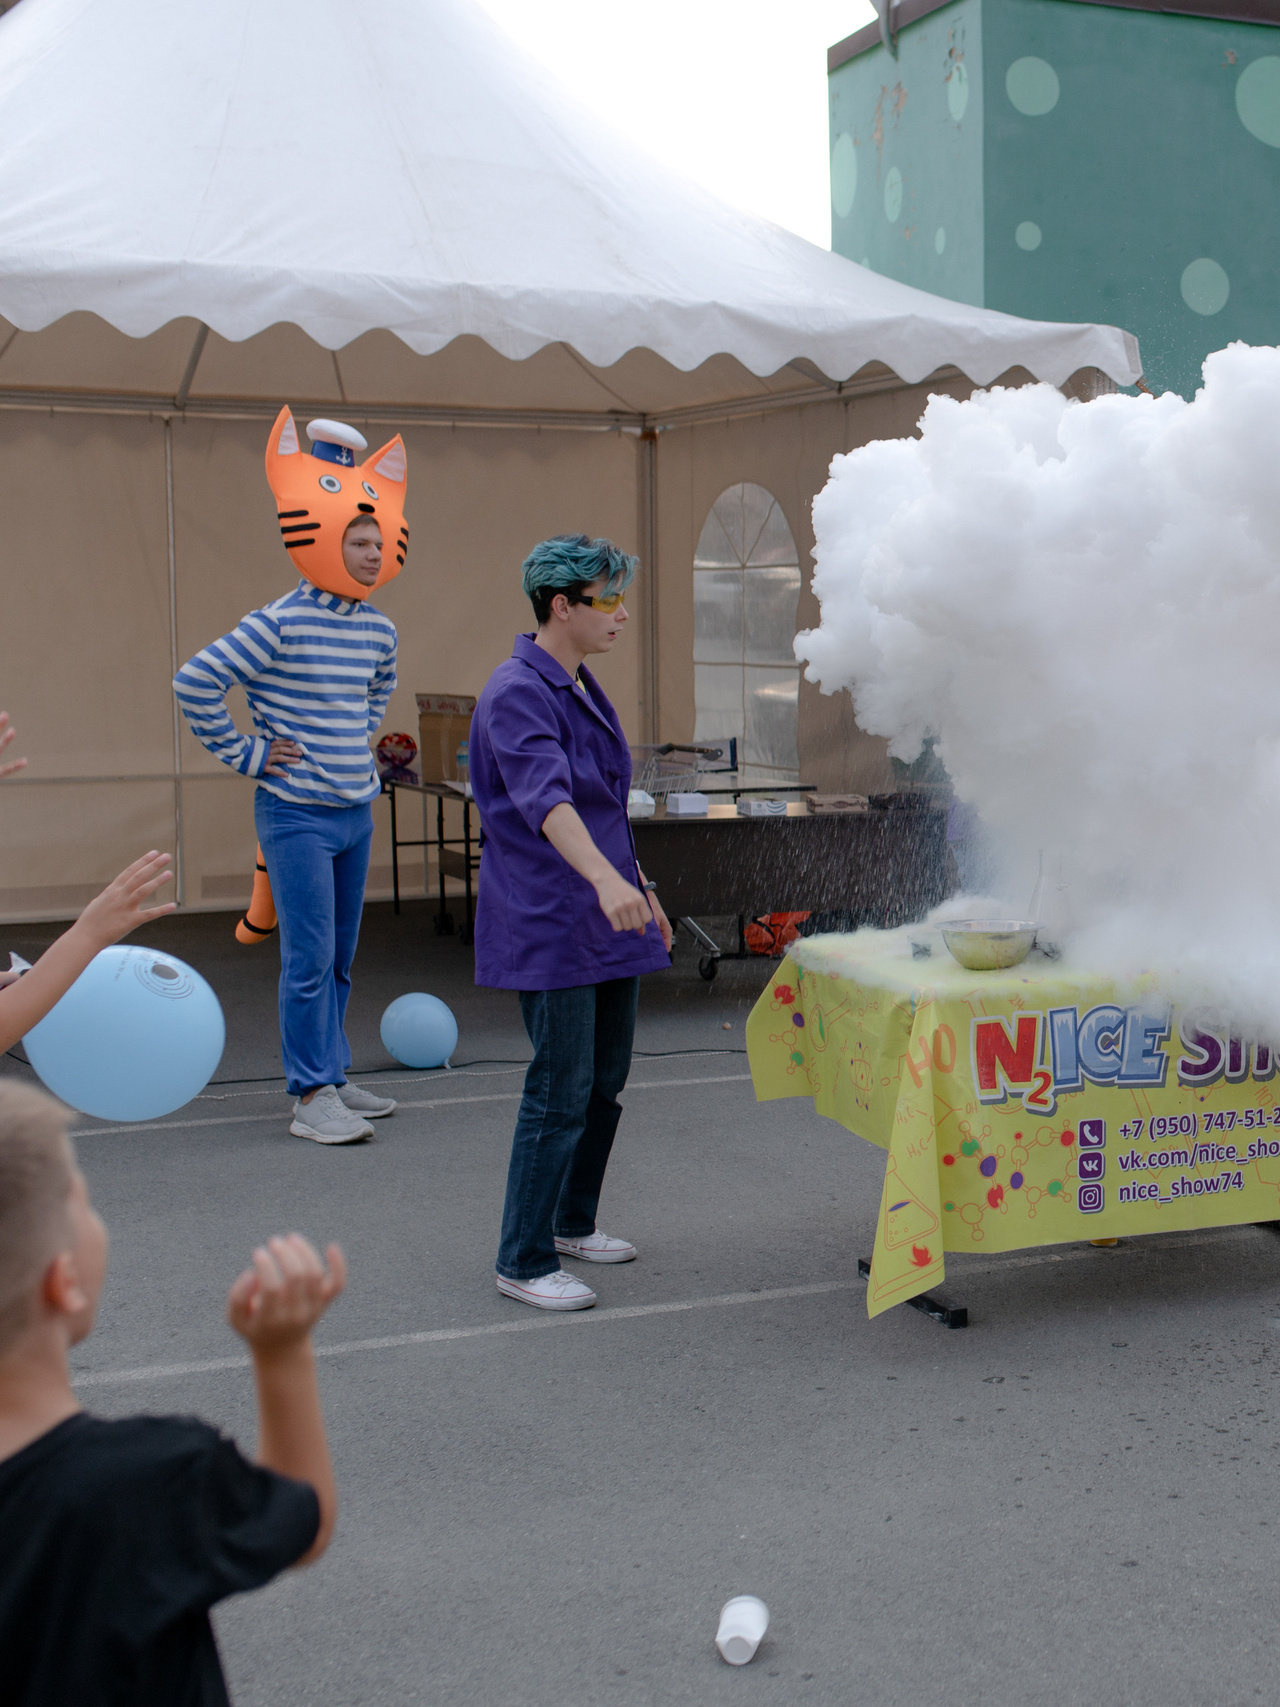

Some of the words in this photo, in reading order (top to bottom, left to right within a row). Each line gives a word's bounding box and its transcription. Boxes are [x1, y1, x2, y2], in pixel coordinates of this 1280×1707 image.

[1119, 1119, 1145, 1141] +7
[1149, 1113, 1198, 1142] (950)
[1118, 1170, 1244, 1203] nice_show74
